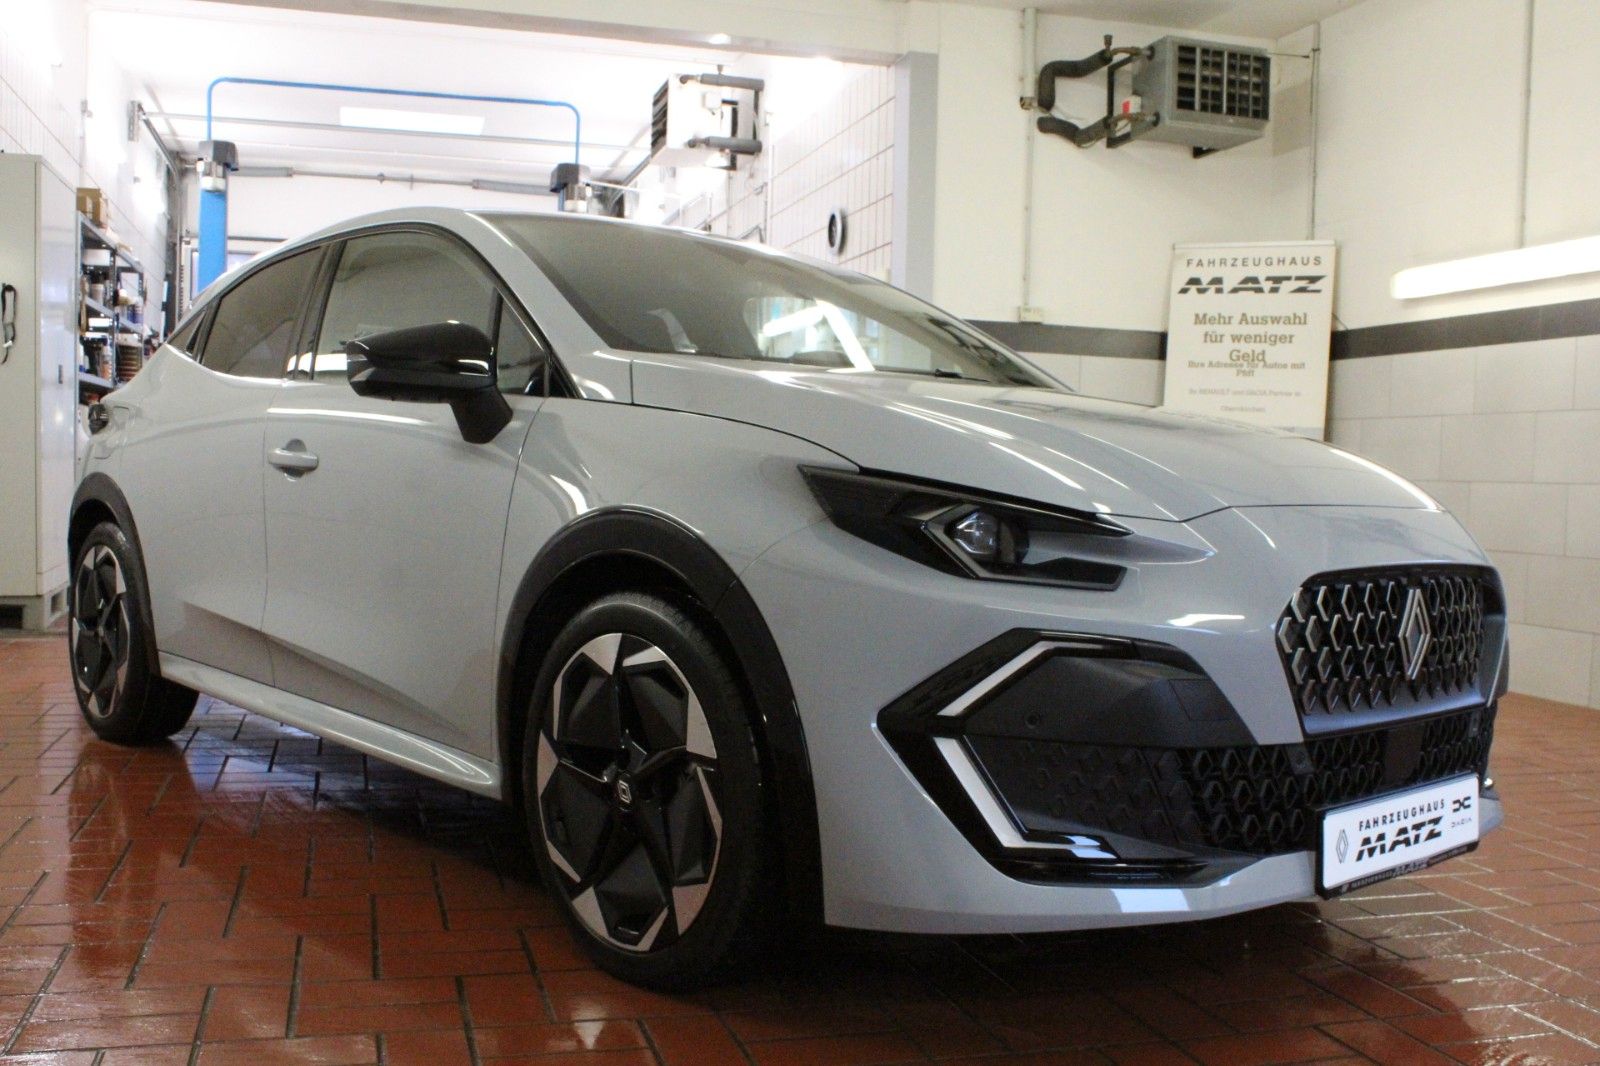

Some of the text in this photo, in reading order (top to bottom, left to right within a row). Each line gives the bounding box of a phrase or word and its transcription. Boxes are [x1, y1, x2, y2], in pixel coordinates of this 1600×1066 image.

[1187, 256, 1322, 267] FAHRZEUGHAUS
[1178, 275, 1327, 294] MATZ
[1194, 313, 1308, 325] Mehr Auswahl
[1203, 331, 1294, 345] für weniger
[1229, 350, 1265, 362] Geld
[1358, 799, 1445, 831] FAHRZEUGHAUS
[1356, 816, 1444, 862] MATZ
